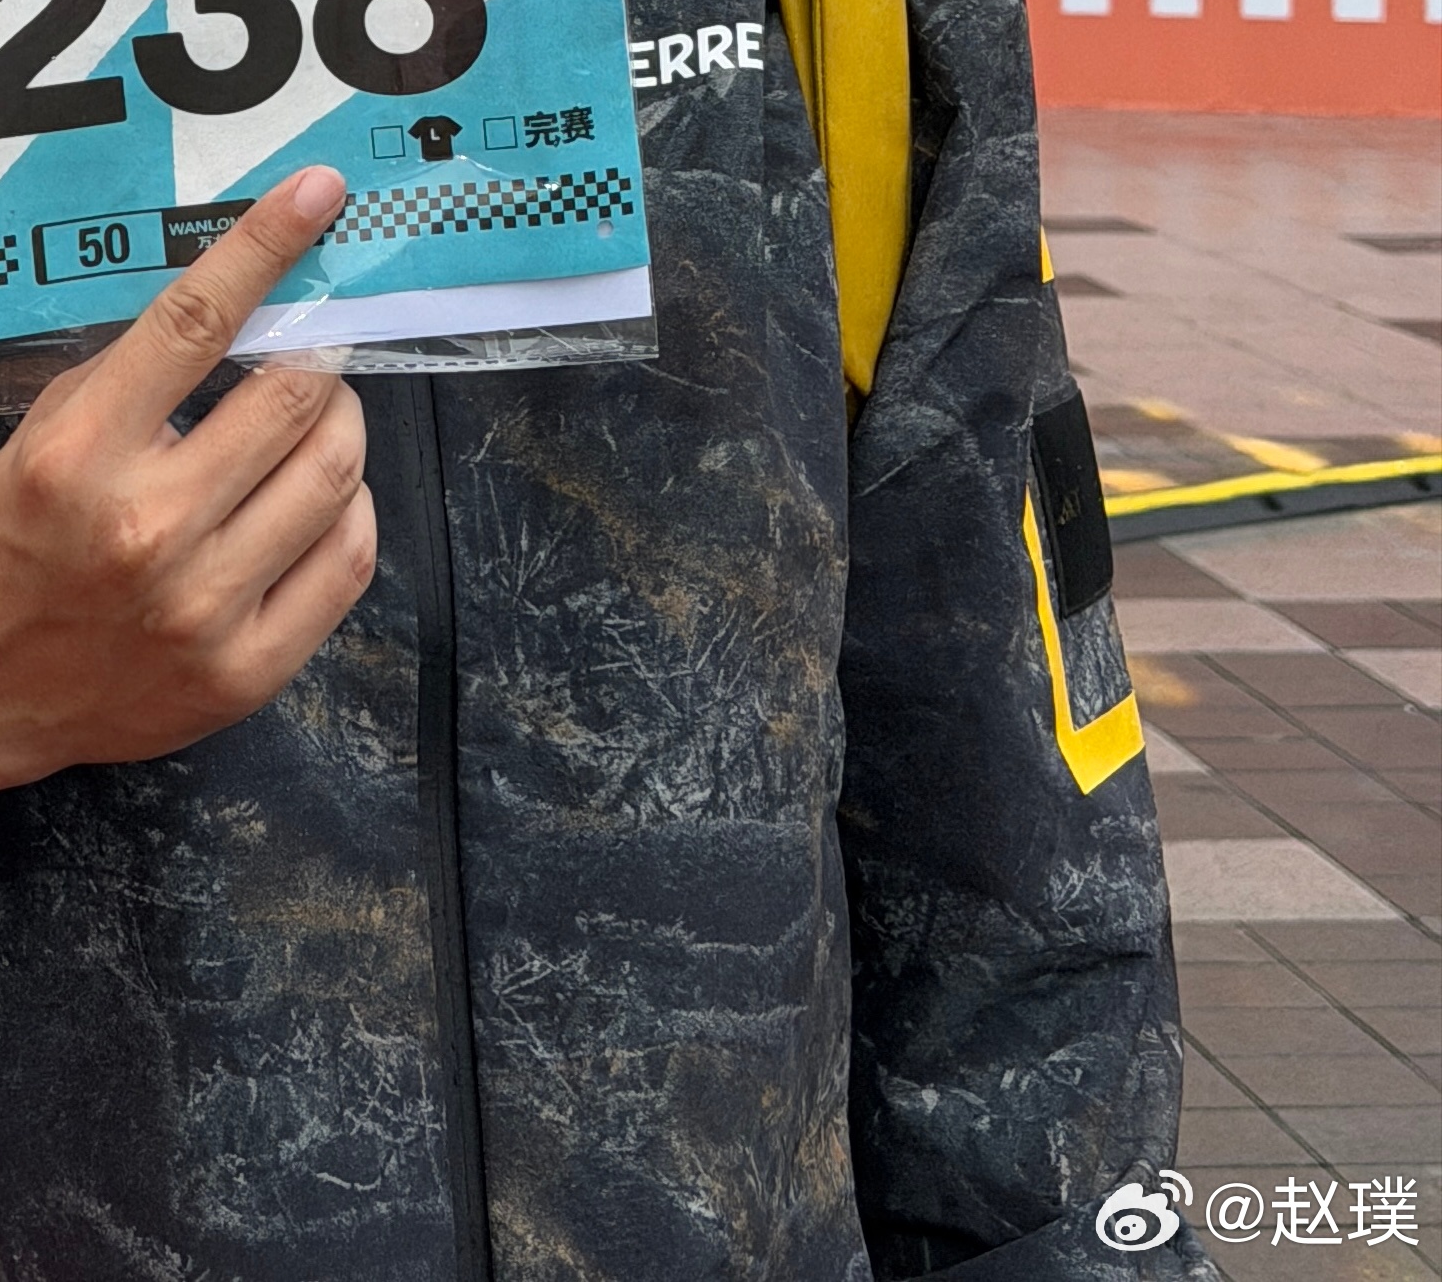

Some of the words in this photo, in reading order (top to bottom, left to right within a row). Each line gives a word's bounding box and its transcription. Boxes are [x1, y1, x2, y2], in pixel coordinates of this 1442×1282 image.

[430, 127, 441, 141] L
[523, 106, 596, 150] 完赛
[78, 222, 131, 268] 50
